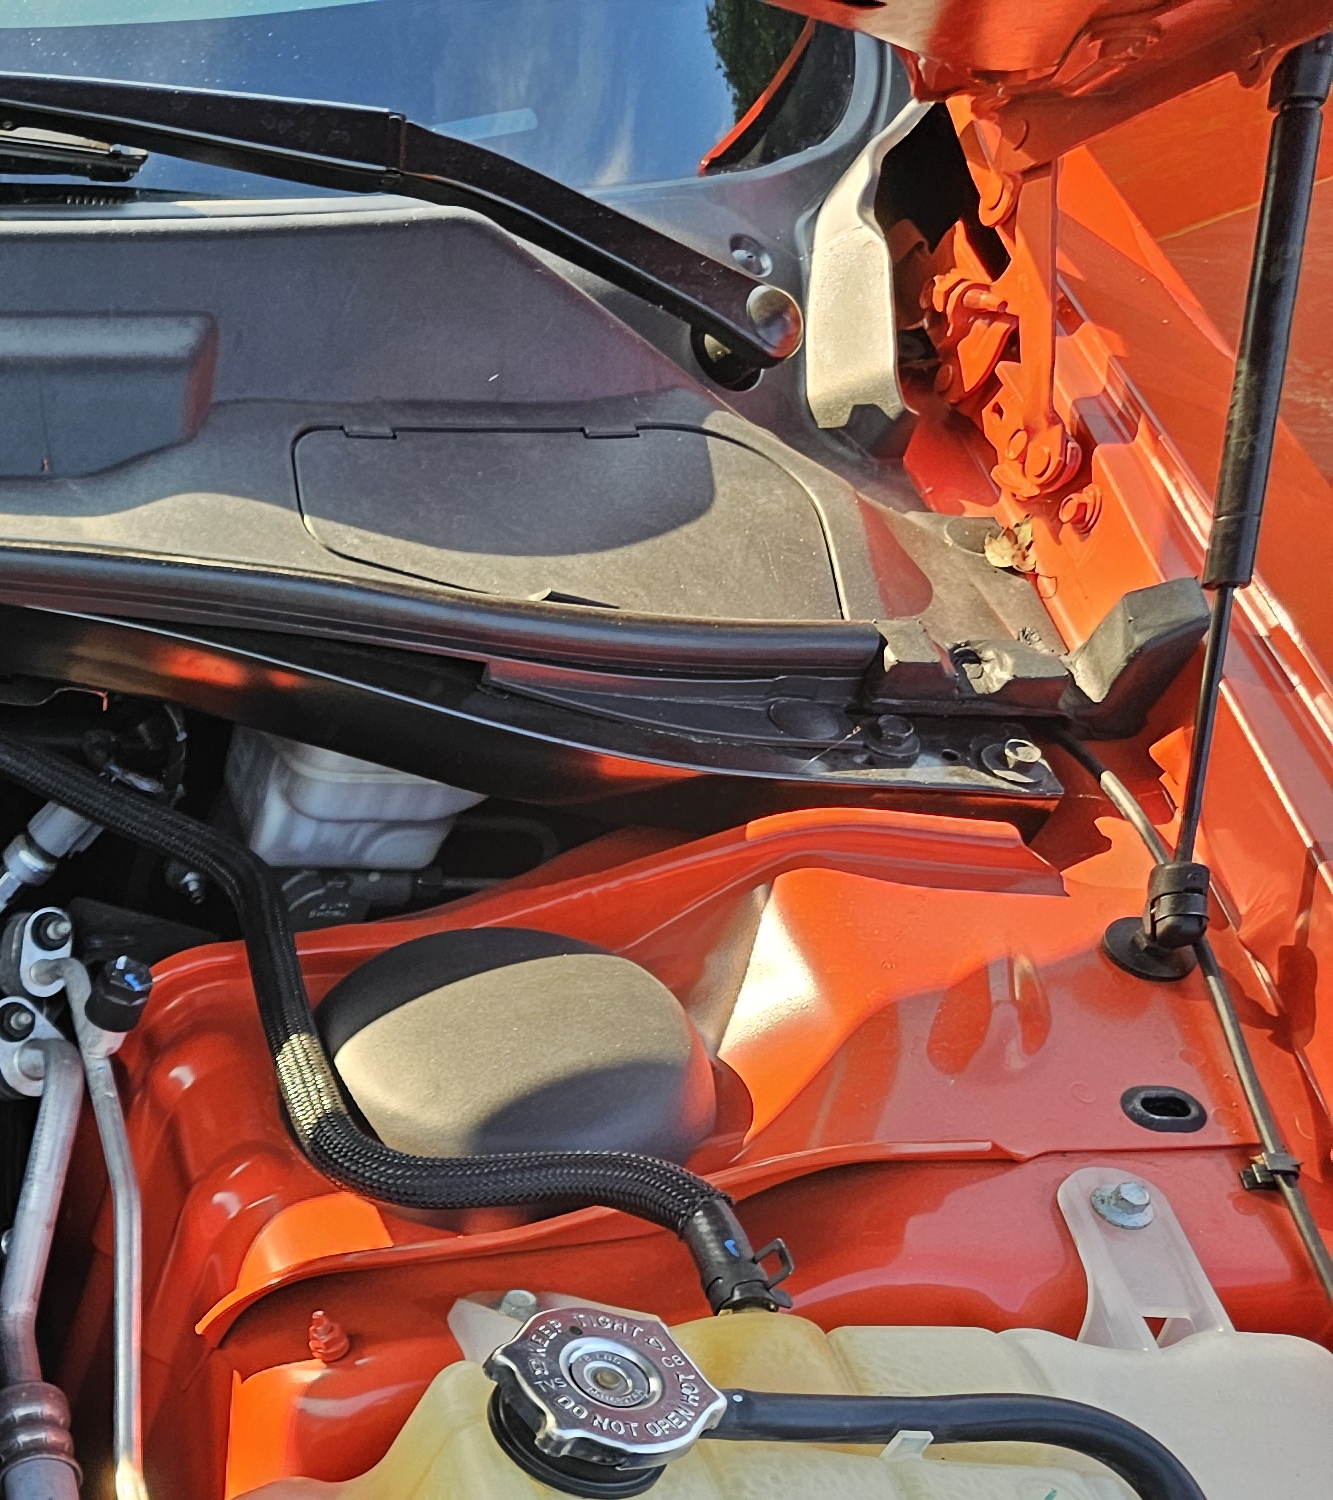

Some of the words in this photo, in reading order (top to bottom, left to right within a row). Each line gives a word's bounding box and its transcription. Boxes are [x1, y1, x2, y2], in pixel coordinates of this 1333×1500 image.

[532, 1319, 562, 1357] KEEP
[573, 1314, 643, 1337] TIGHT
[535, 1378, 567, 1392] TVS
[556, 1396, 588, 1419] DO
[593, 1414, 638, 1436] NOT
[645, 1406, 695, 1436] OPEN
[676, 1371, 700, 1406] HOT
